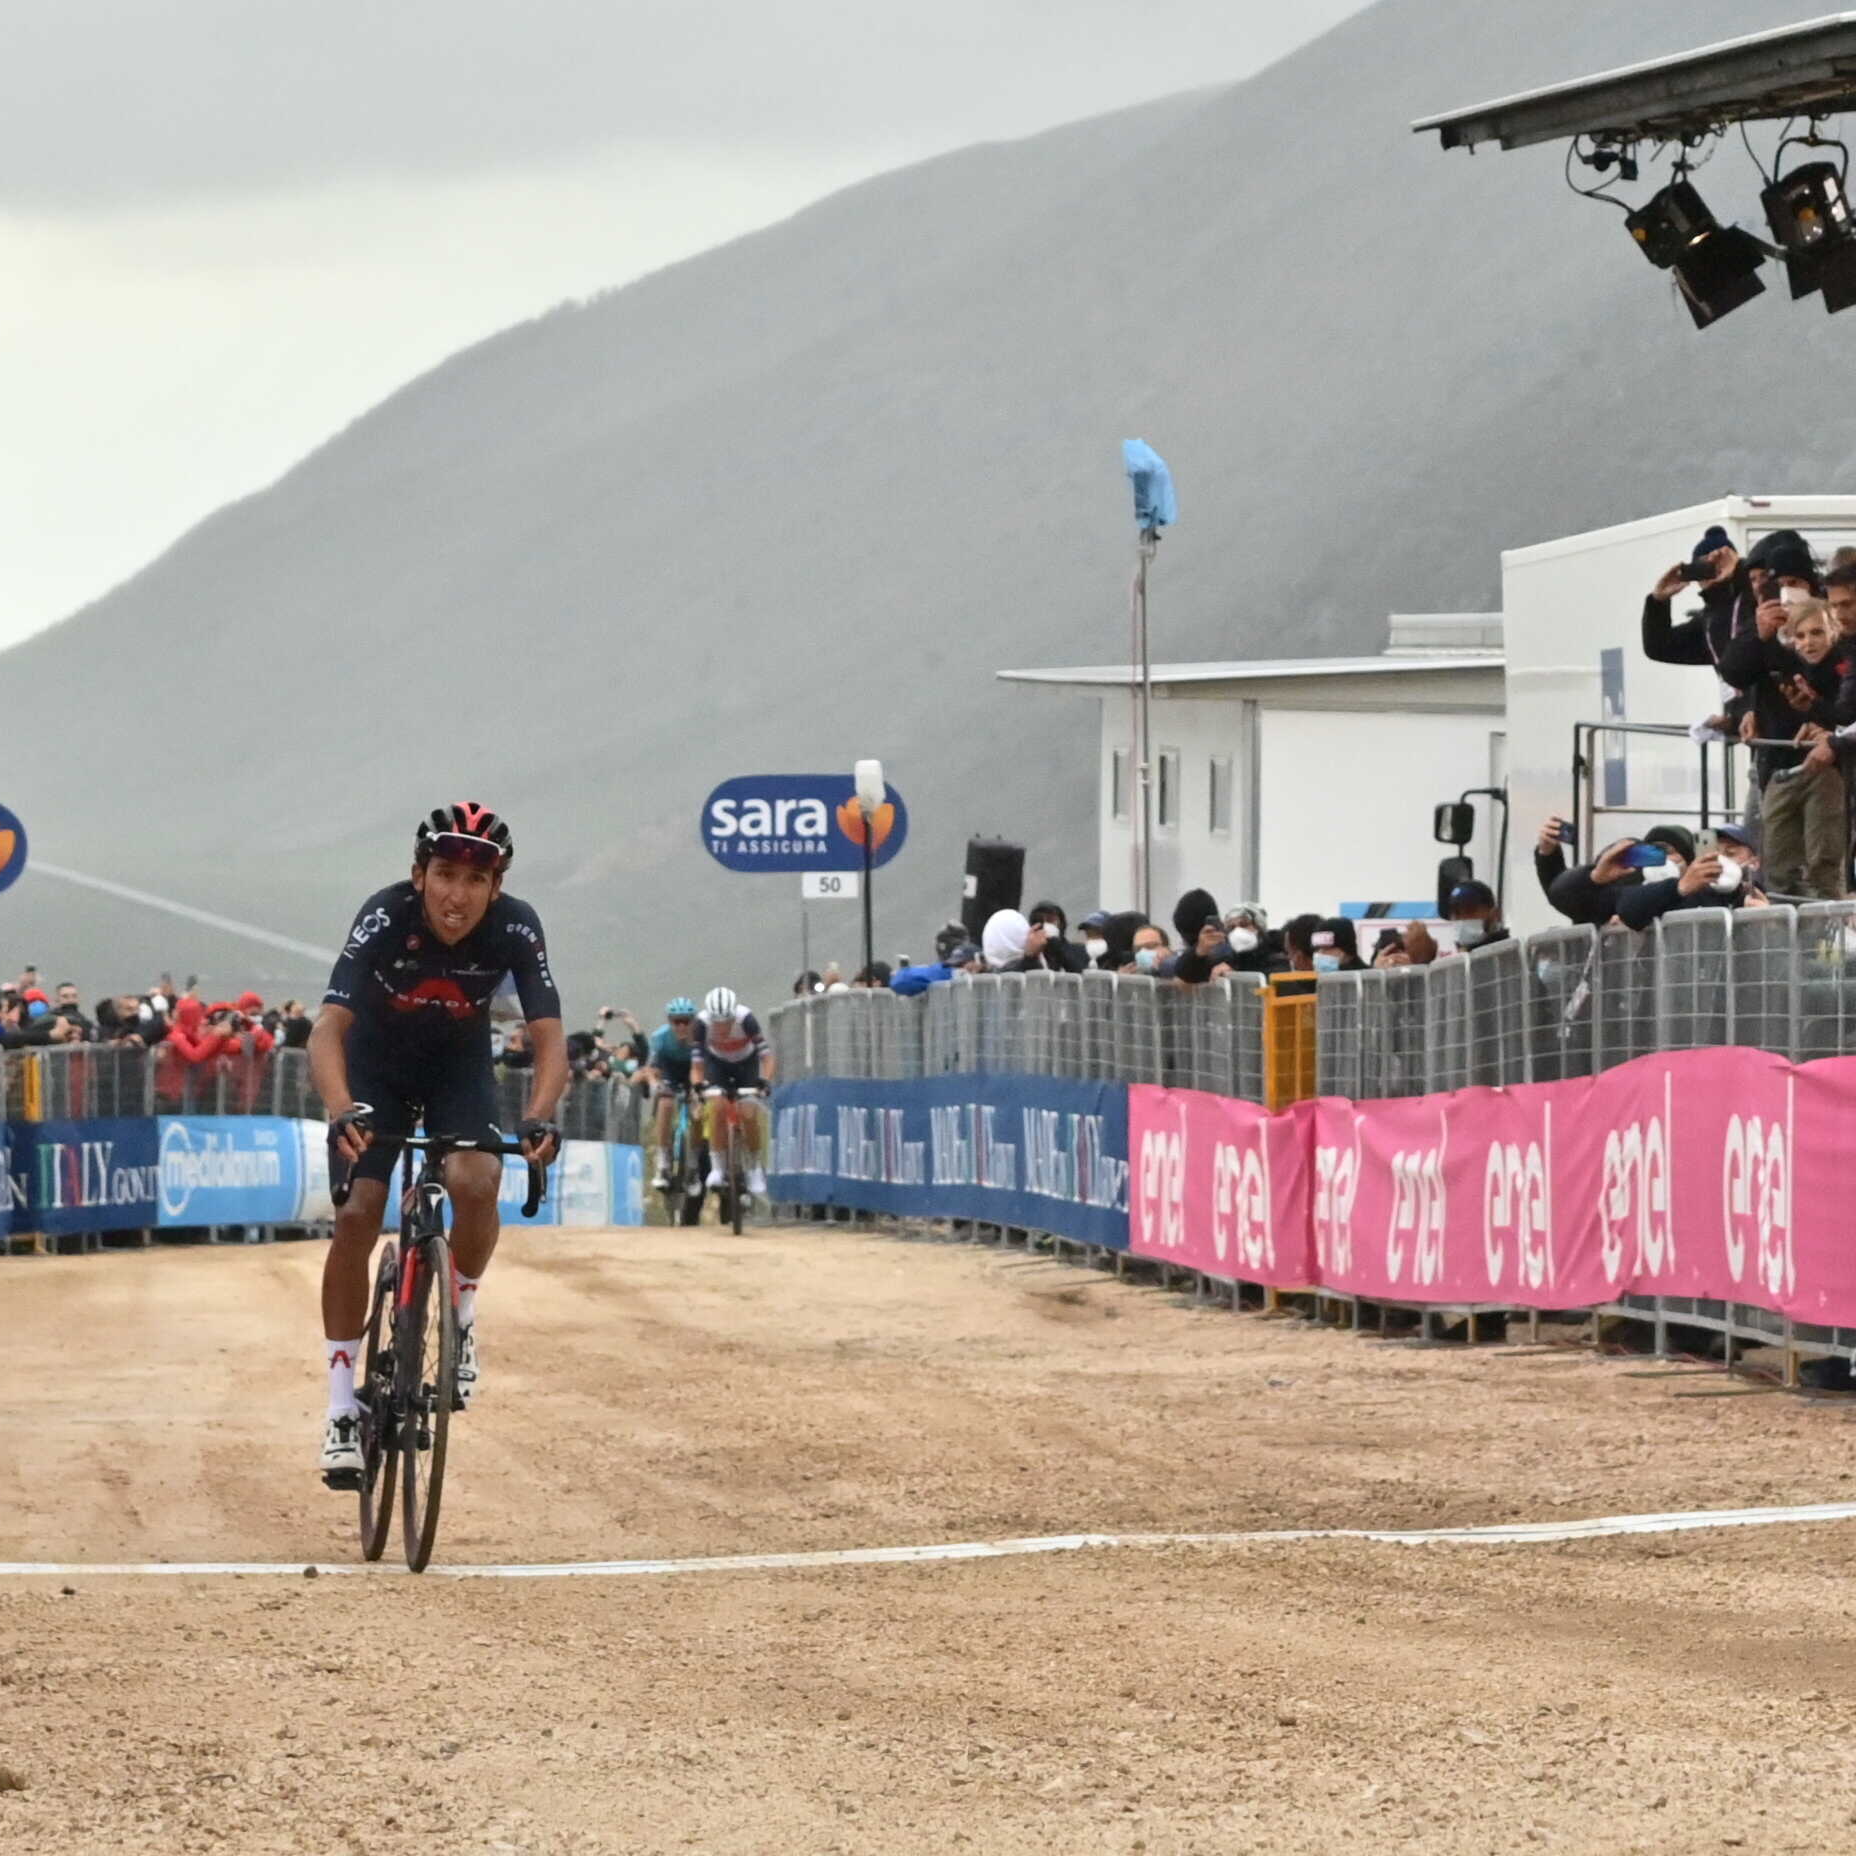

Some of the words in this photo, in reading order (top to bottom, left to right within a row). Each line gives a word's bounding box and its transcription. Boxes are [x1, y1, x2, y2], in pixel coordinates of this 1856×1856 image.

[710, 797, 828, 838] sara
[711, 840, 729, 854] TI
[737, 840, 828, 854] ASSICURA
[819, 876, 842, 894] 50
[343, 907, 391, 960] INEOS
[1142, 1102, 1188, 1245] enel
[1212, 1114, 1276, 1270] enel
[1386, 1107, 1448, 1286] enel
[1484, 1099, 1556, 1292] enel
[1600, 1070, 1676, 1284] enel
[1722, 1074, 1796, 1296] enel
